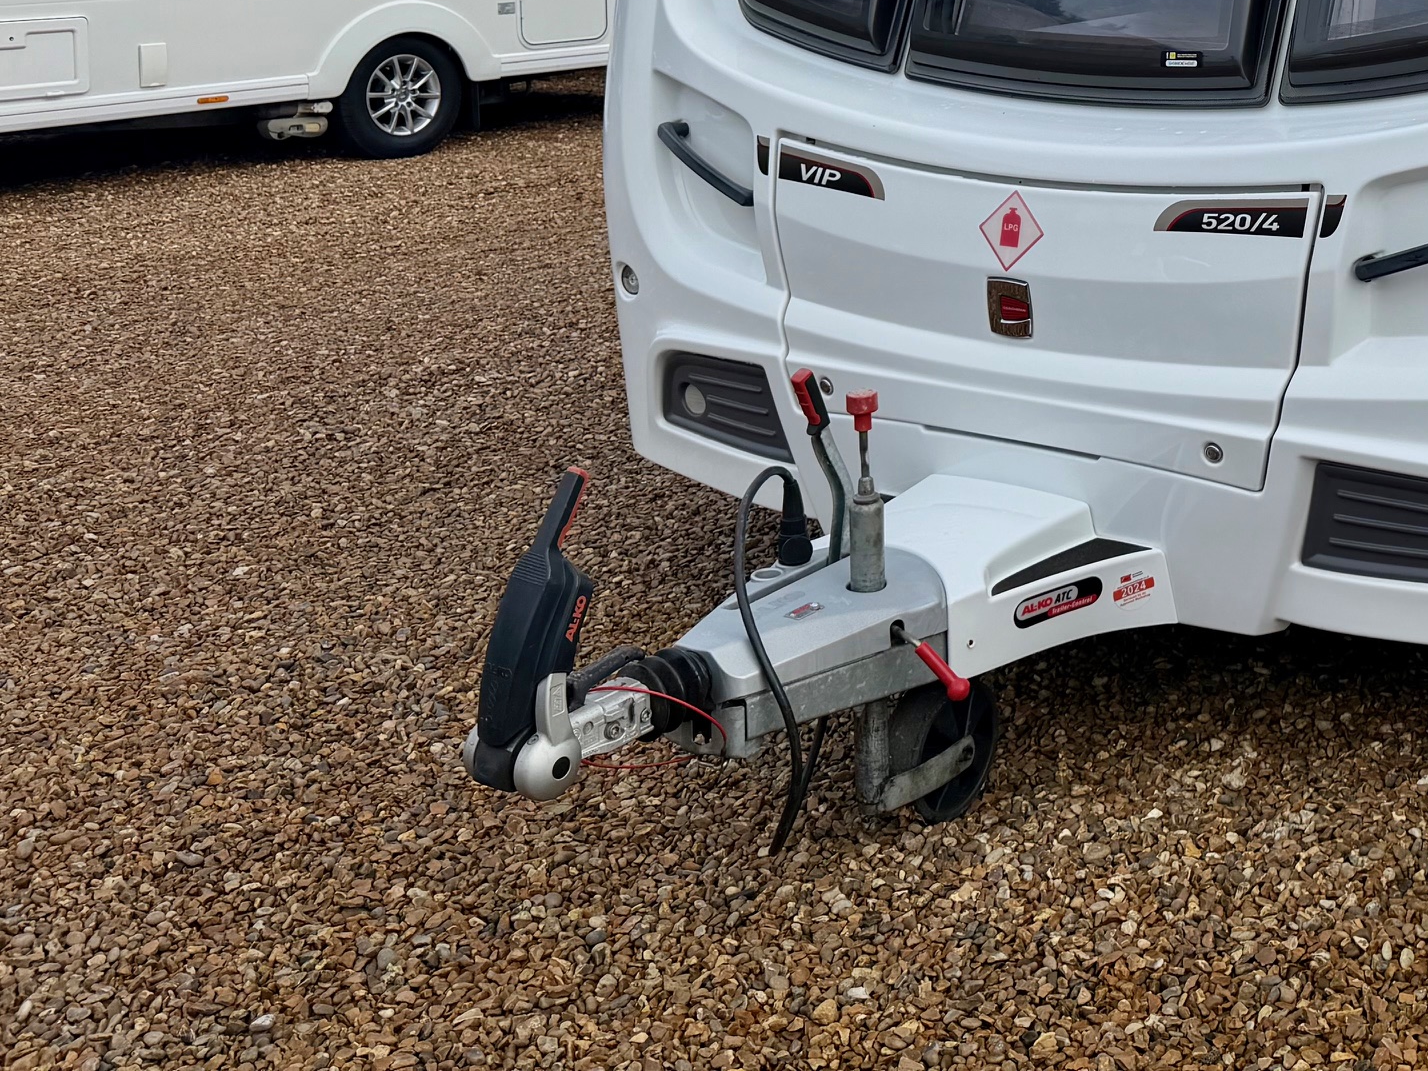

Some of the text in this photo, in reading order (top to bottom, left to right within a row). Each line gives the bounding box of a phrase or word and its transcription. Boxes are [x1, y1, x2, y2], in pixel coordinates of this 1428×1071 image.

[800, 163, 841, 185] VIP
[1003, 222, 1019, 232] LPG
[1201, 213, 1280, 232] 520/4
[1121, 580, 1147, 598] 2024
[1021, 589, 1074, 617] AL-KO ATC
[565, 595, 587, 642] AL-KO
